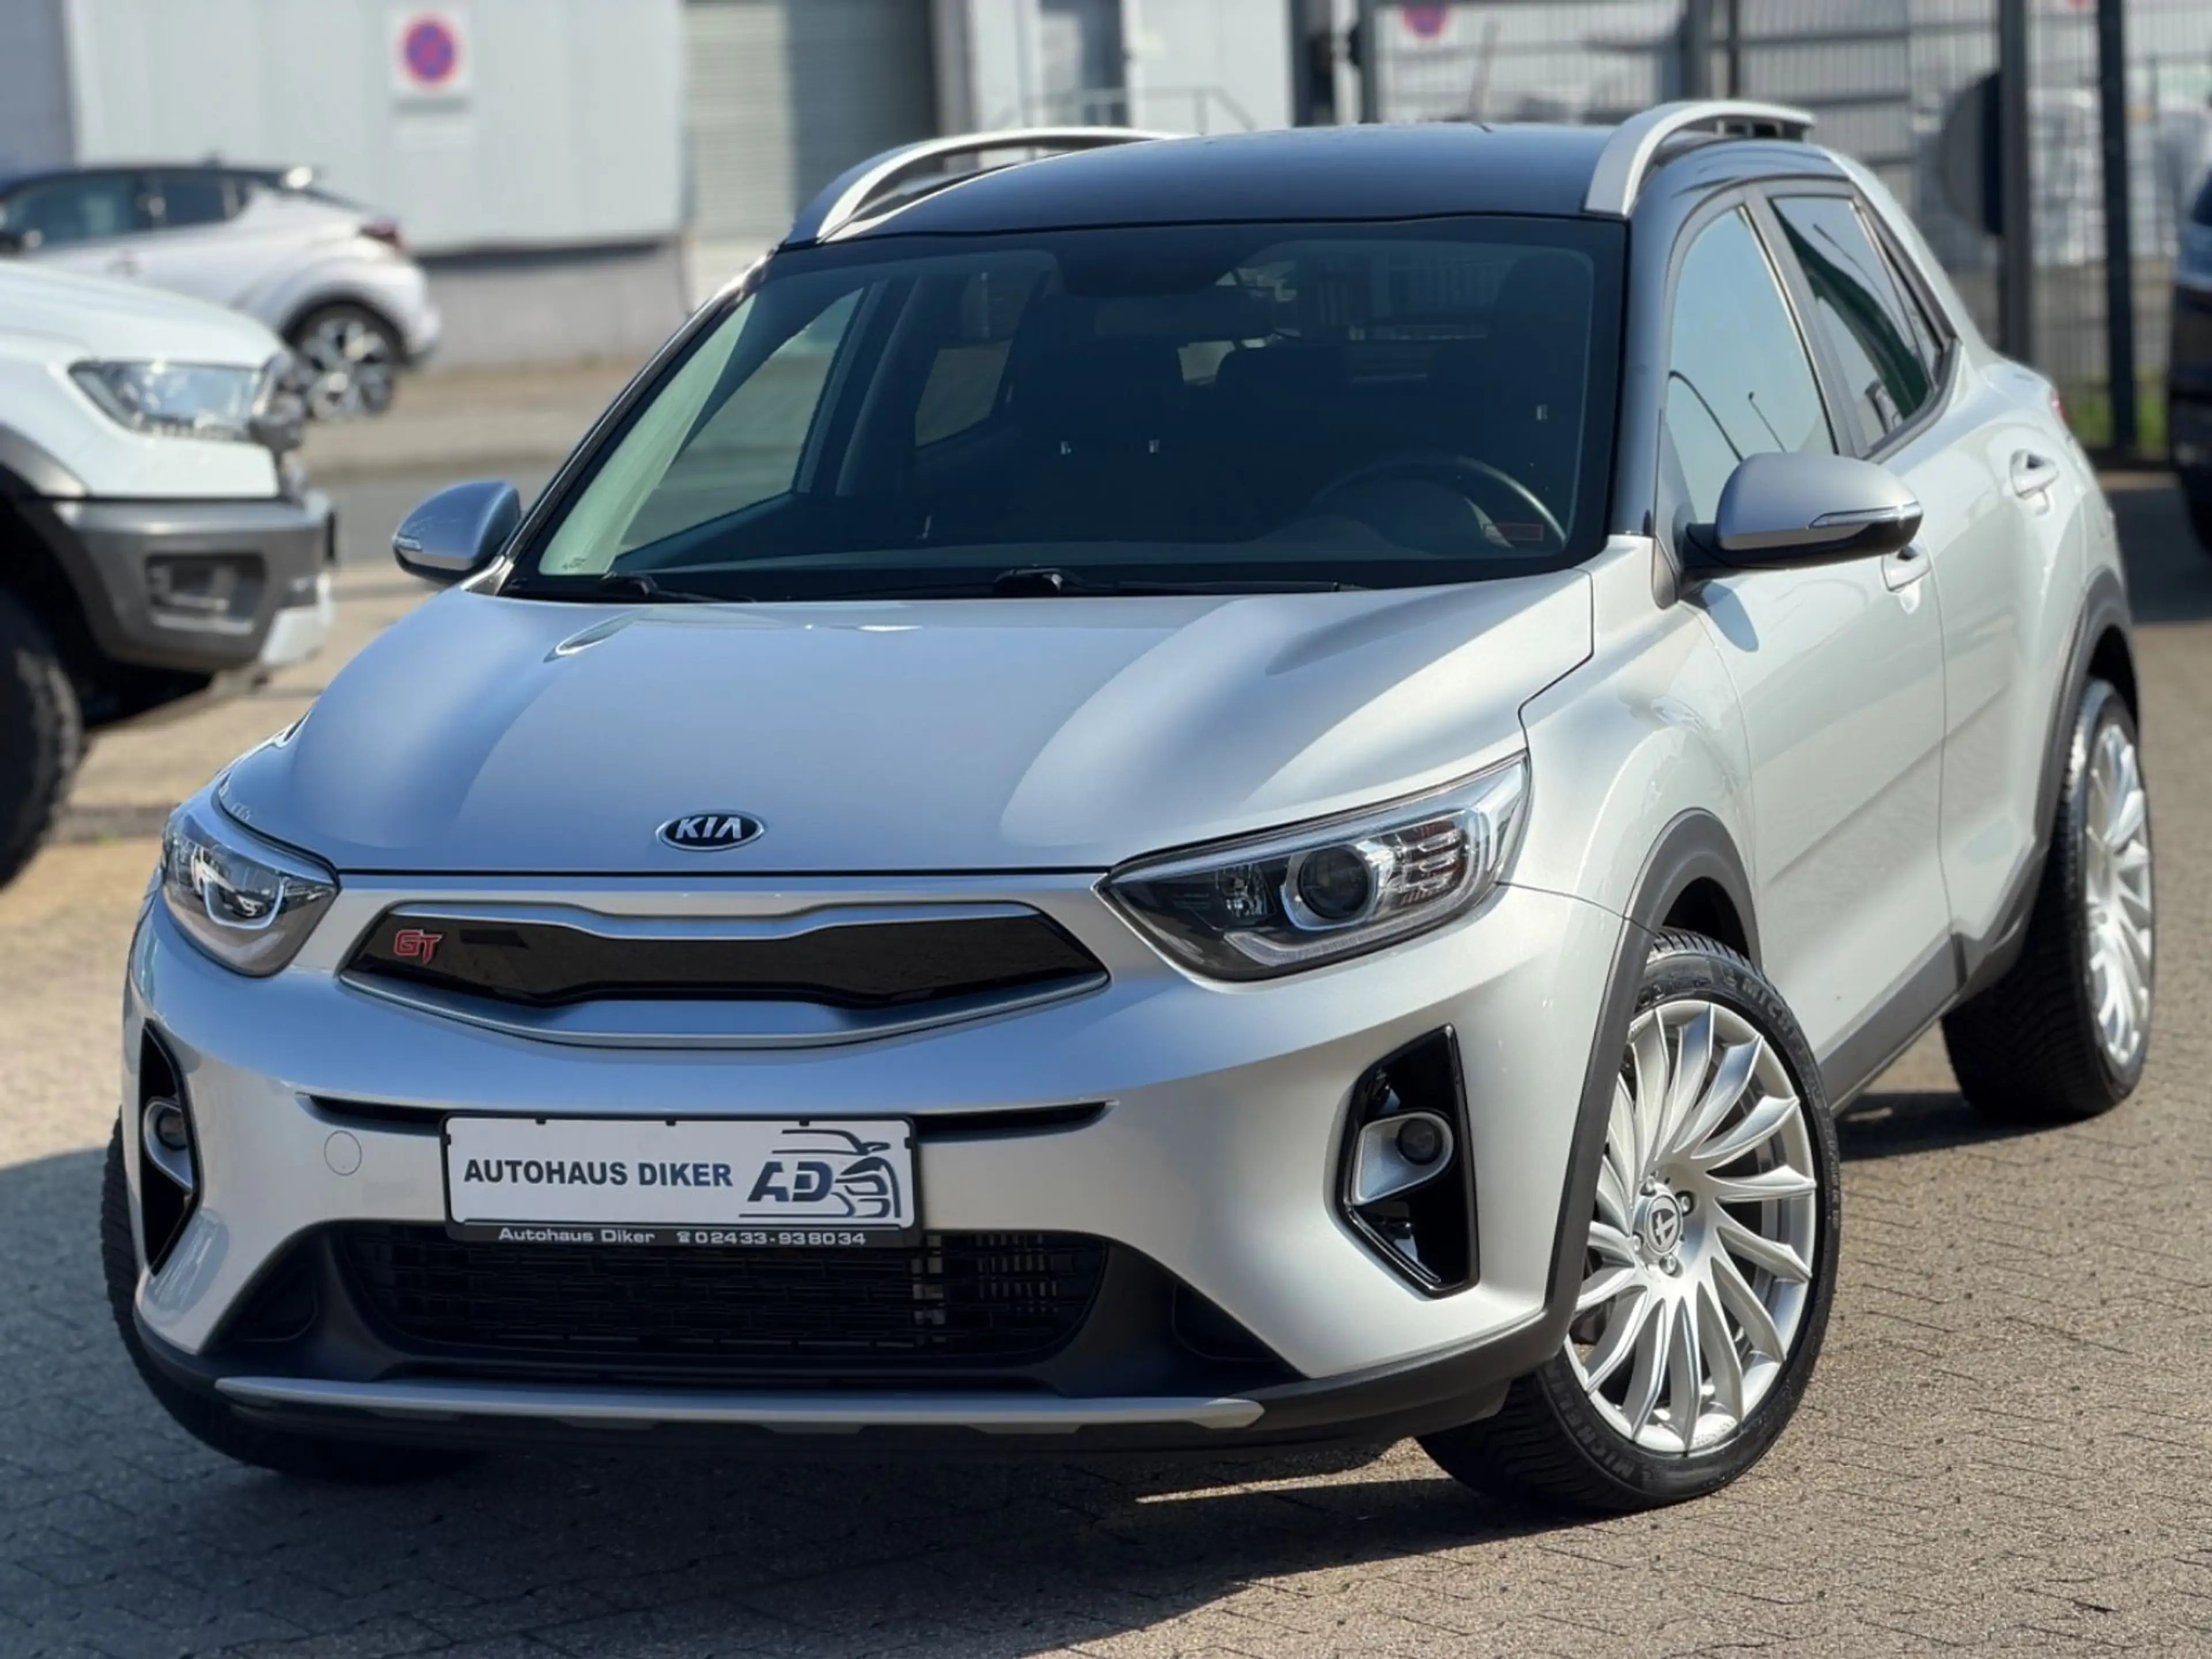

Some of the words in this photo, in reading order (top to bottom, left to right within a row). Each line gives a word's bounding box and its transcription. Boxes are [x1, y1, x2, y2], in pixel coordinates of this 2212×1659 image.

[675, 816, 741, 839] KIA
[394, 929, 442, 964] GT
[464, 1159, 628, 1185] AUTOHAUS
[638, 1162, 733, 1187] DIKER
[498, 1228, 594, 1242] Autohaus
[601, 1229, 656, 1244] Diker
[695, 1232, 866, 1247] 02433-938034
